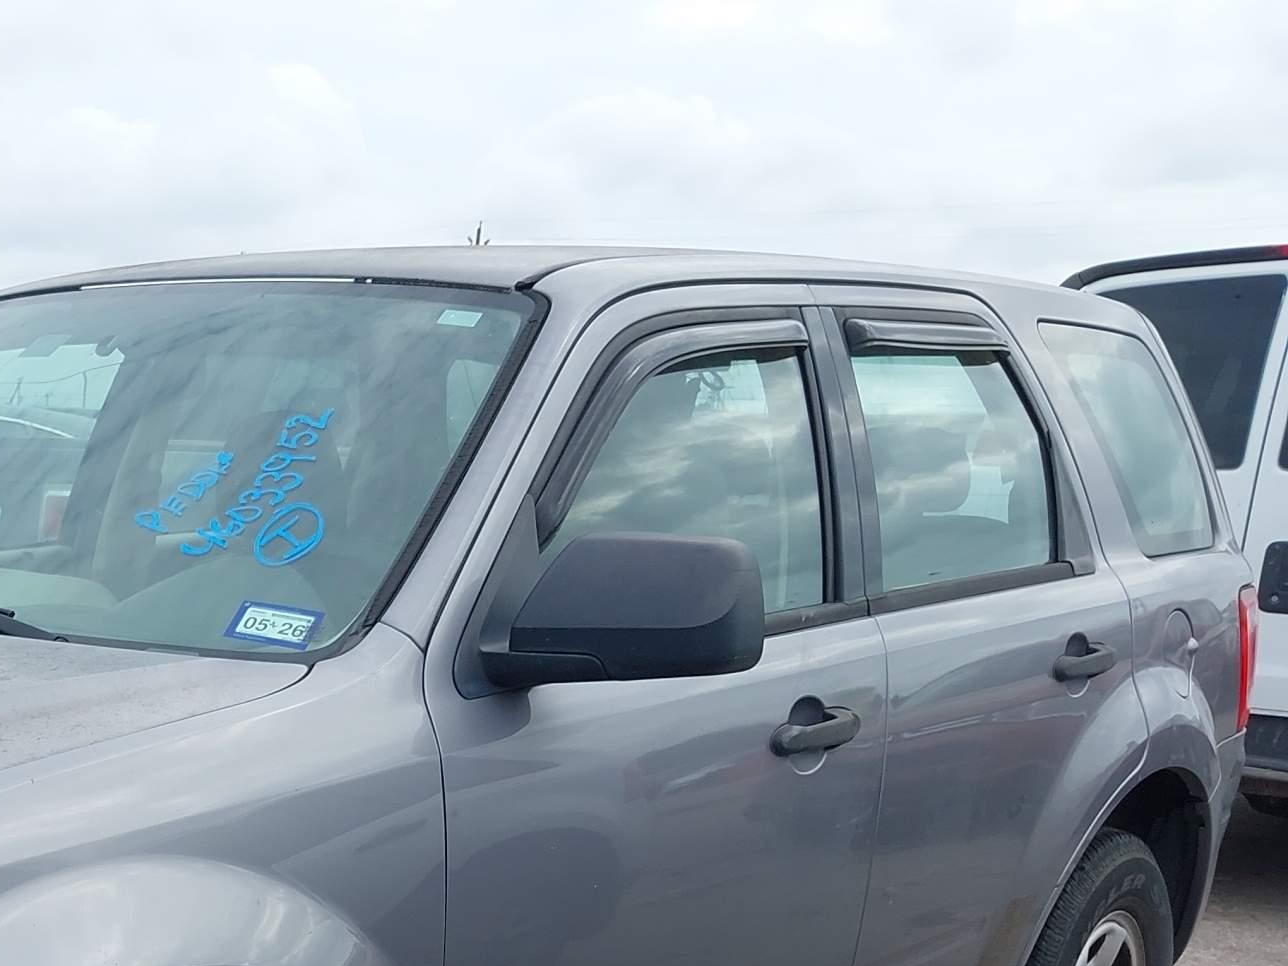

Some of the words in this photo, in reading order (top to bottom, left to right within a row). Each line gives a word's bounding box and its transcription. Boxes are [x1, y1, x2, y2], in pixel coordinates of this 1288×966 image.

[180, 408, 334, 556] 46033952
[243, 616, 270, 632] 05
[277, 622, 306, 638] 26
